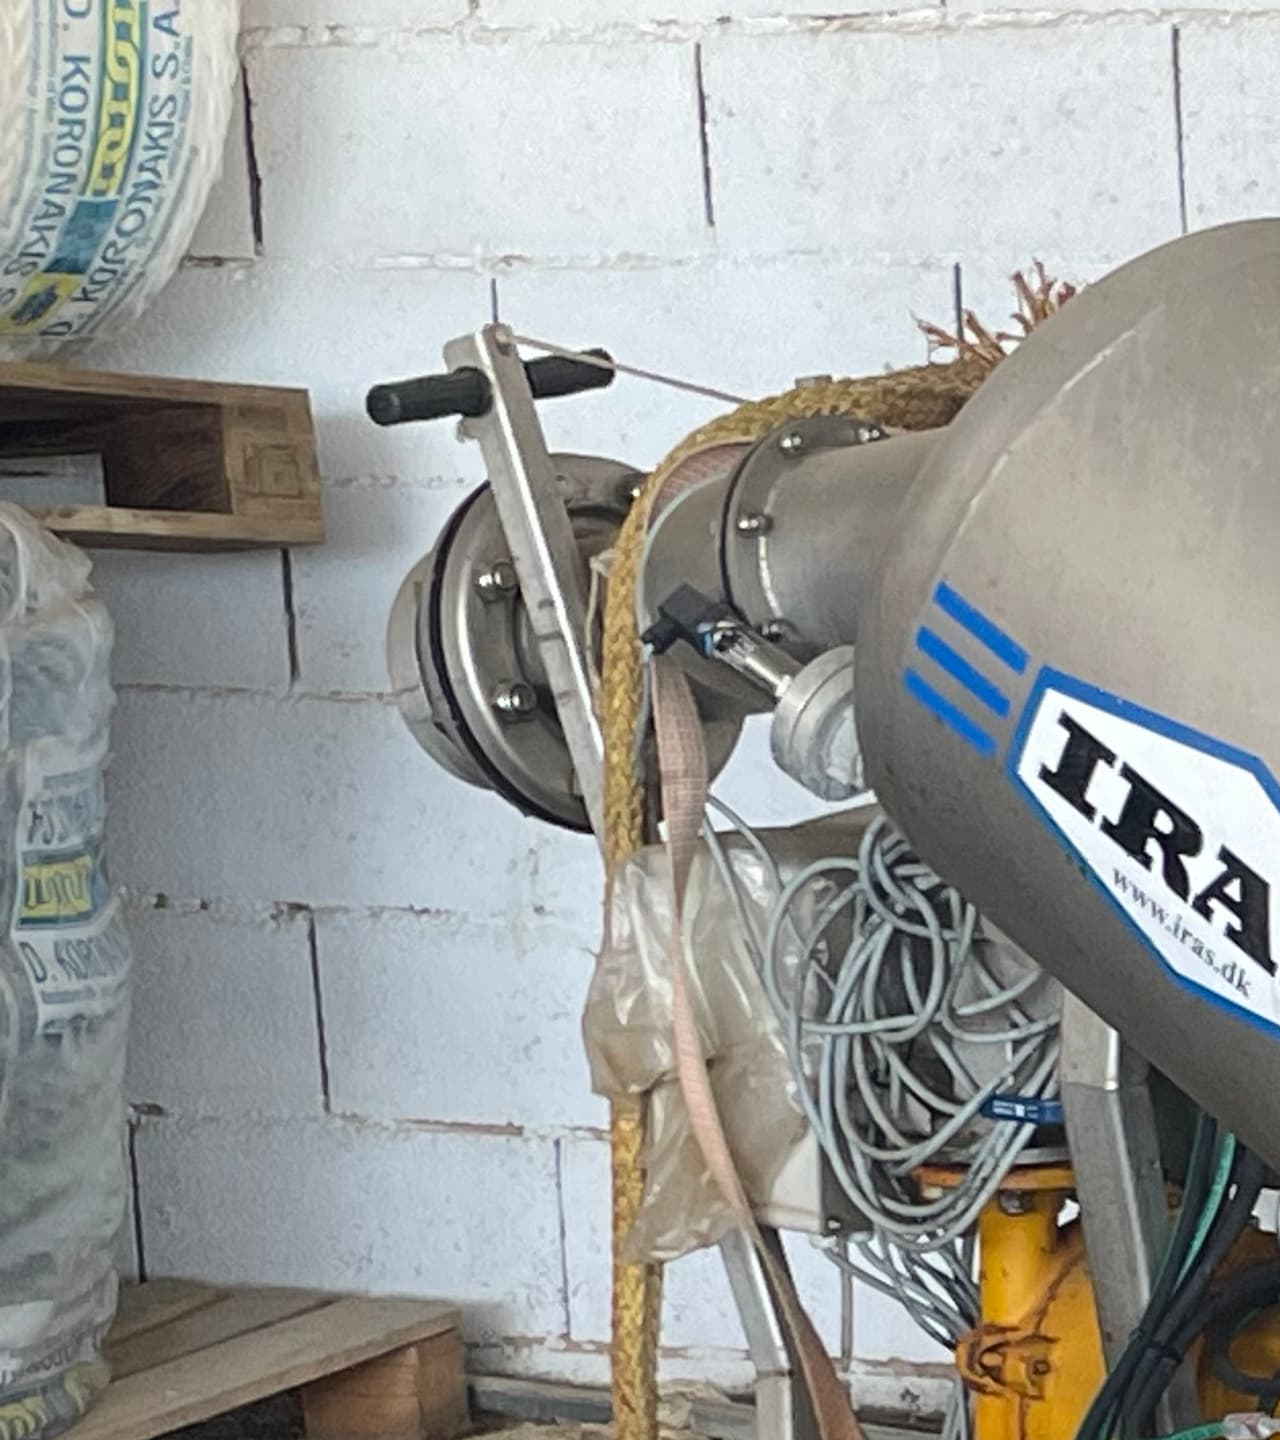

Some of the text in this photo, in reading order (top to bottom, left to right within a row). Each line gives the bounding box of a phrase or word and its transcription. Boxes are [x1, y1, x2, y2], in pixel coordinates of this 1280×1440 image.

[4, 56, 91, 277] KORONAKIS
[71, 94, 179, 302] KORONAKIS
[1112, 867, 1253, 1000] www.iras.dk
